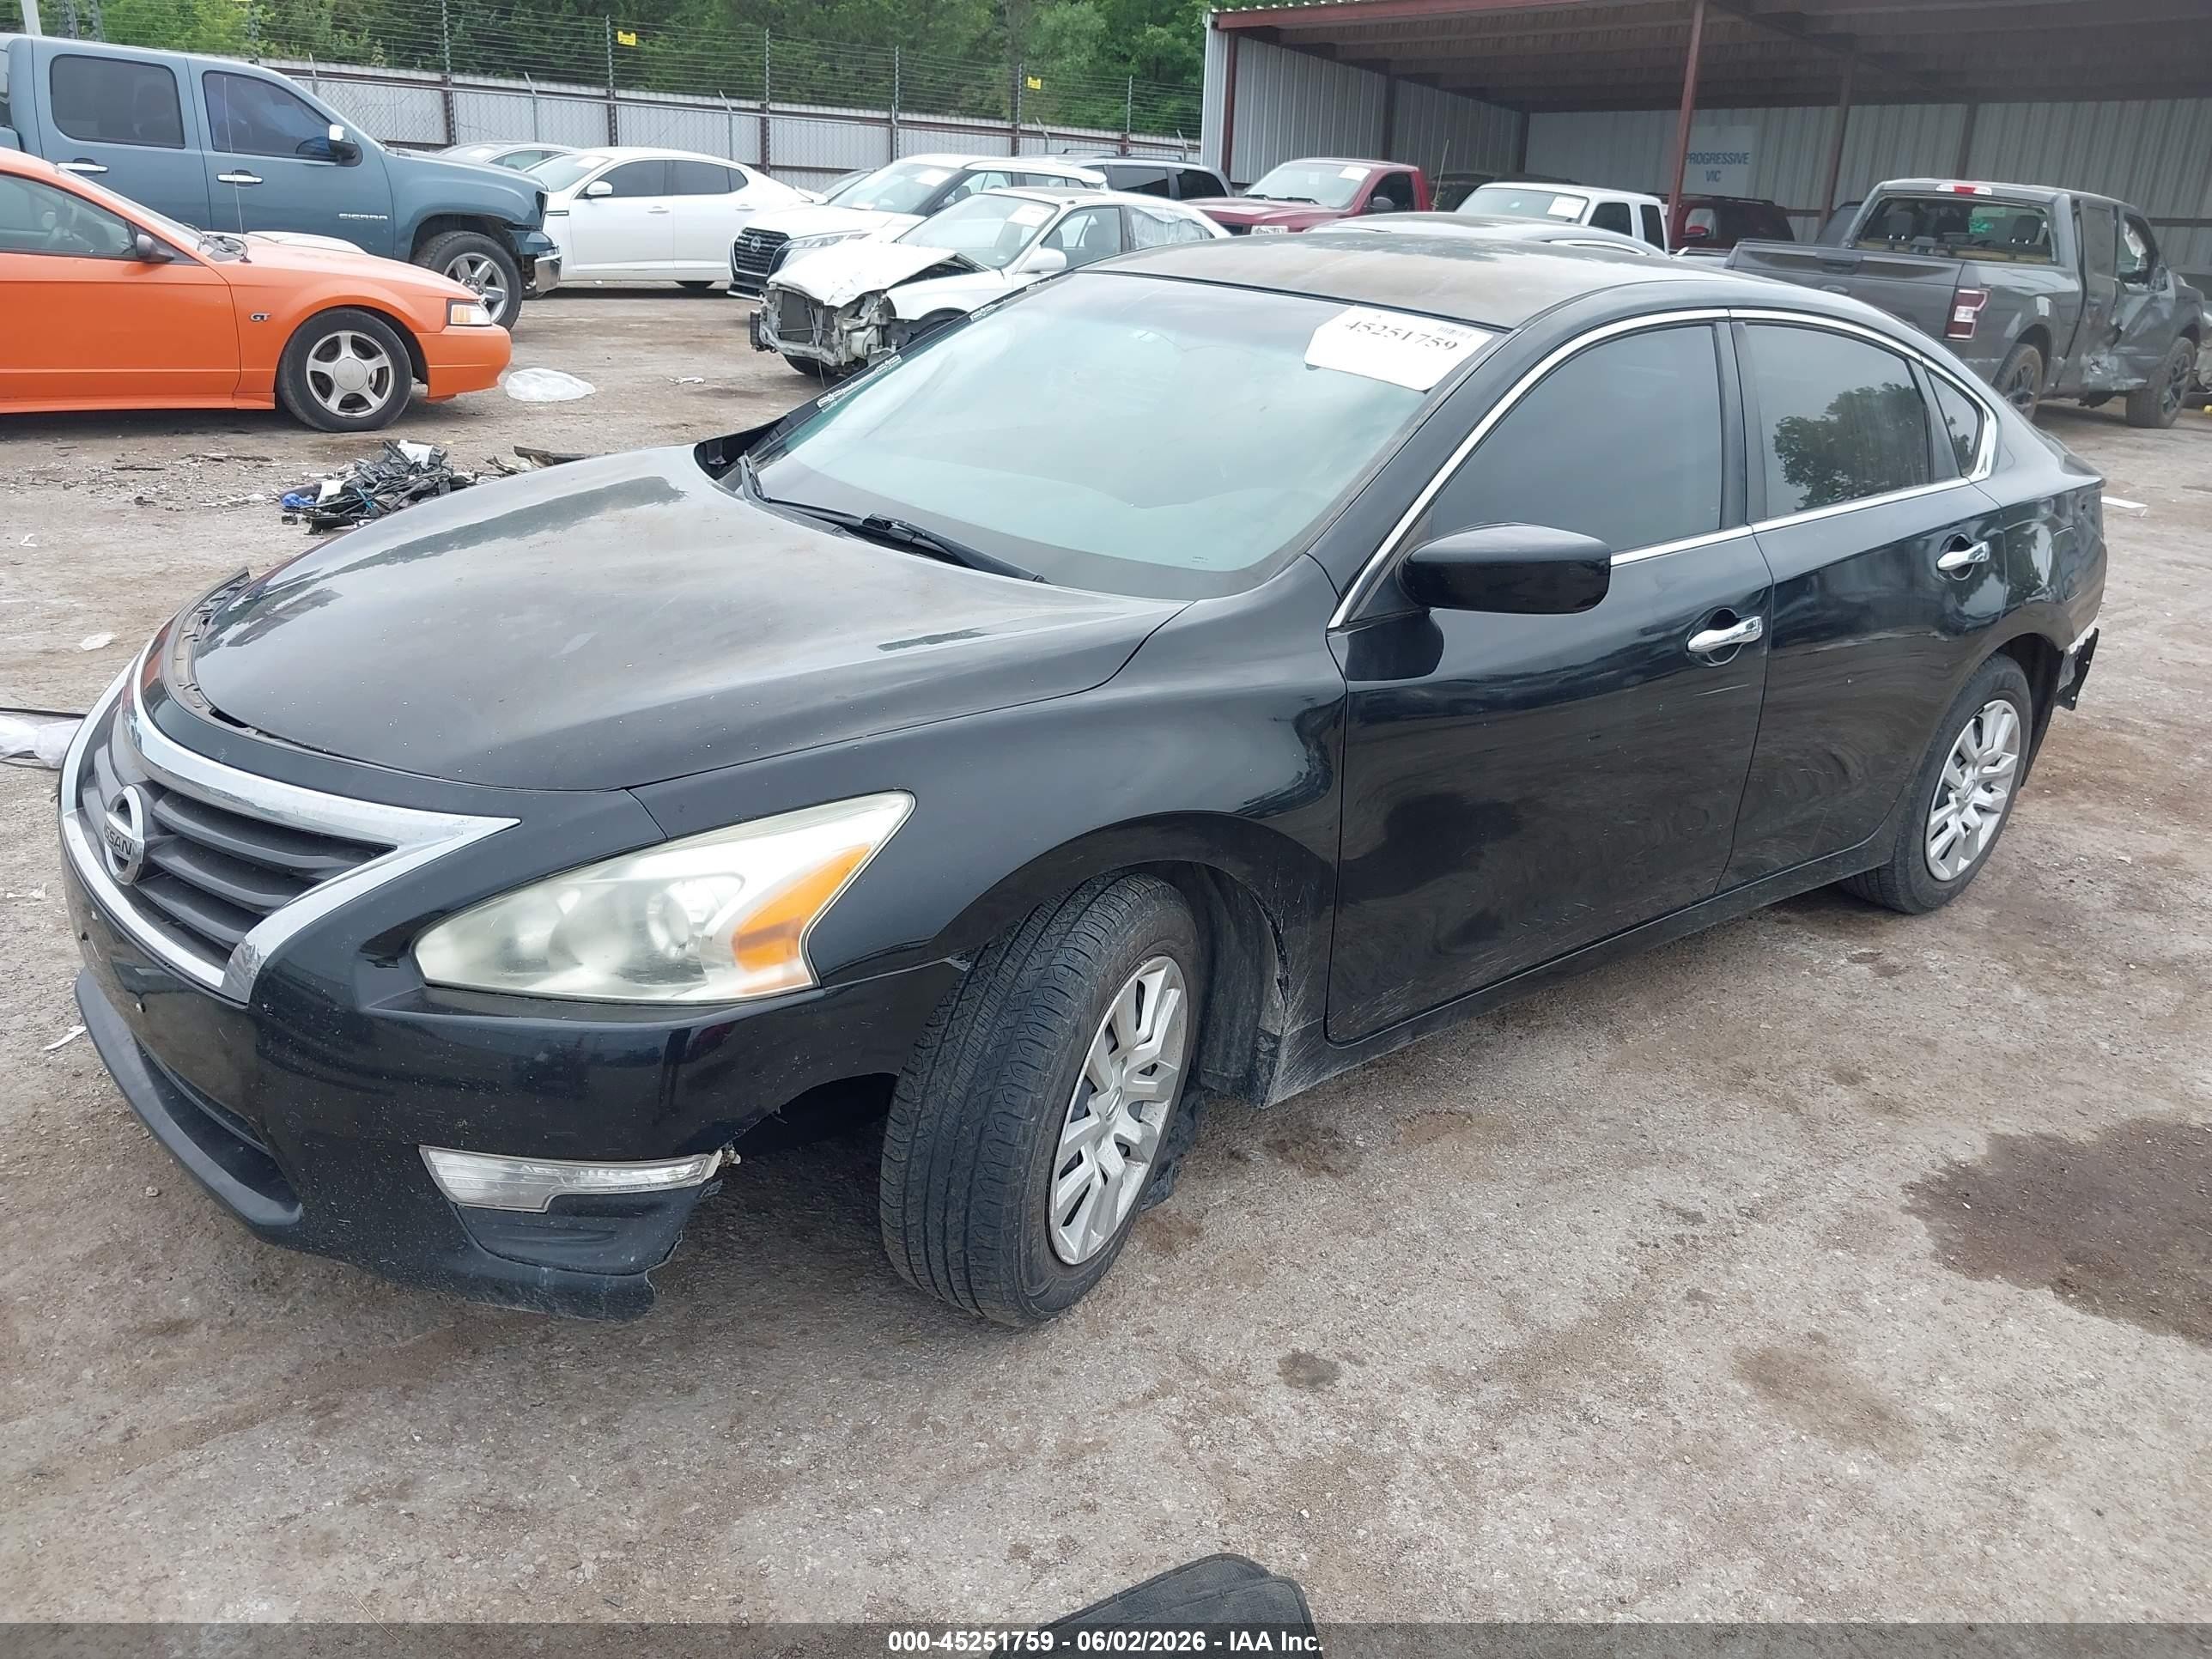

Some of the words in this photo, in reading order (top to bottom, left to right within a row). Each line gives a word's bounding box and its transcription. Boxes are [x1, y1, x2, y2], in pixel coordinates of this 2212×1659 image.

[1684, 152, 1750, 165] PROGRESSIVE
[1705, 170, 1722, 183] VIC
[338, 211, 389, 221] SIERRA
[250, 313, 271, 322] GT
[1346, 320, 1459, 351] 45251759
[103, 822, 133, 856] ISSAN
